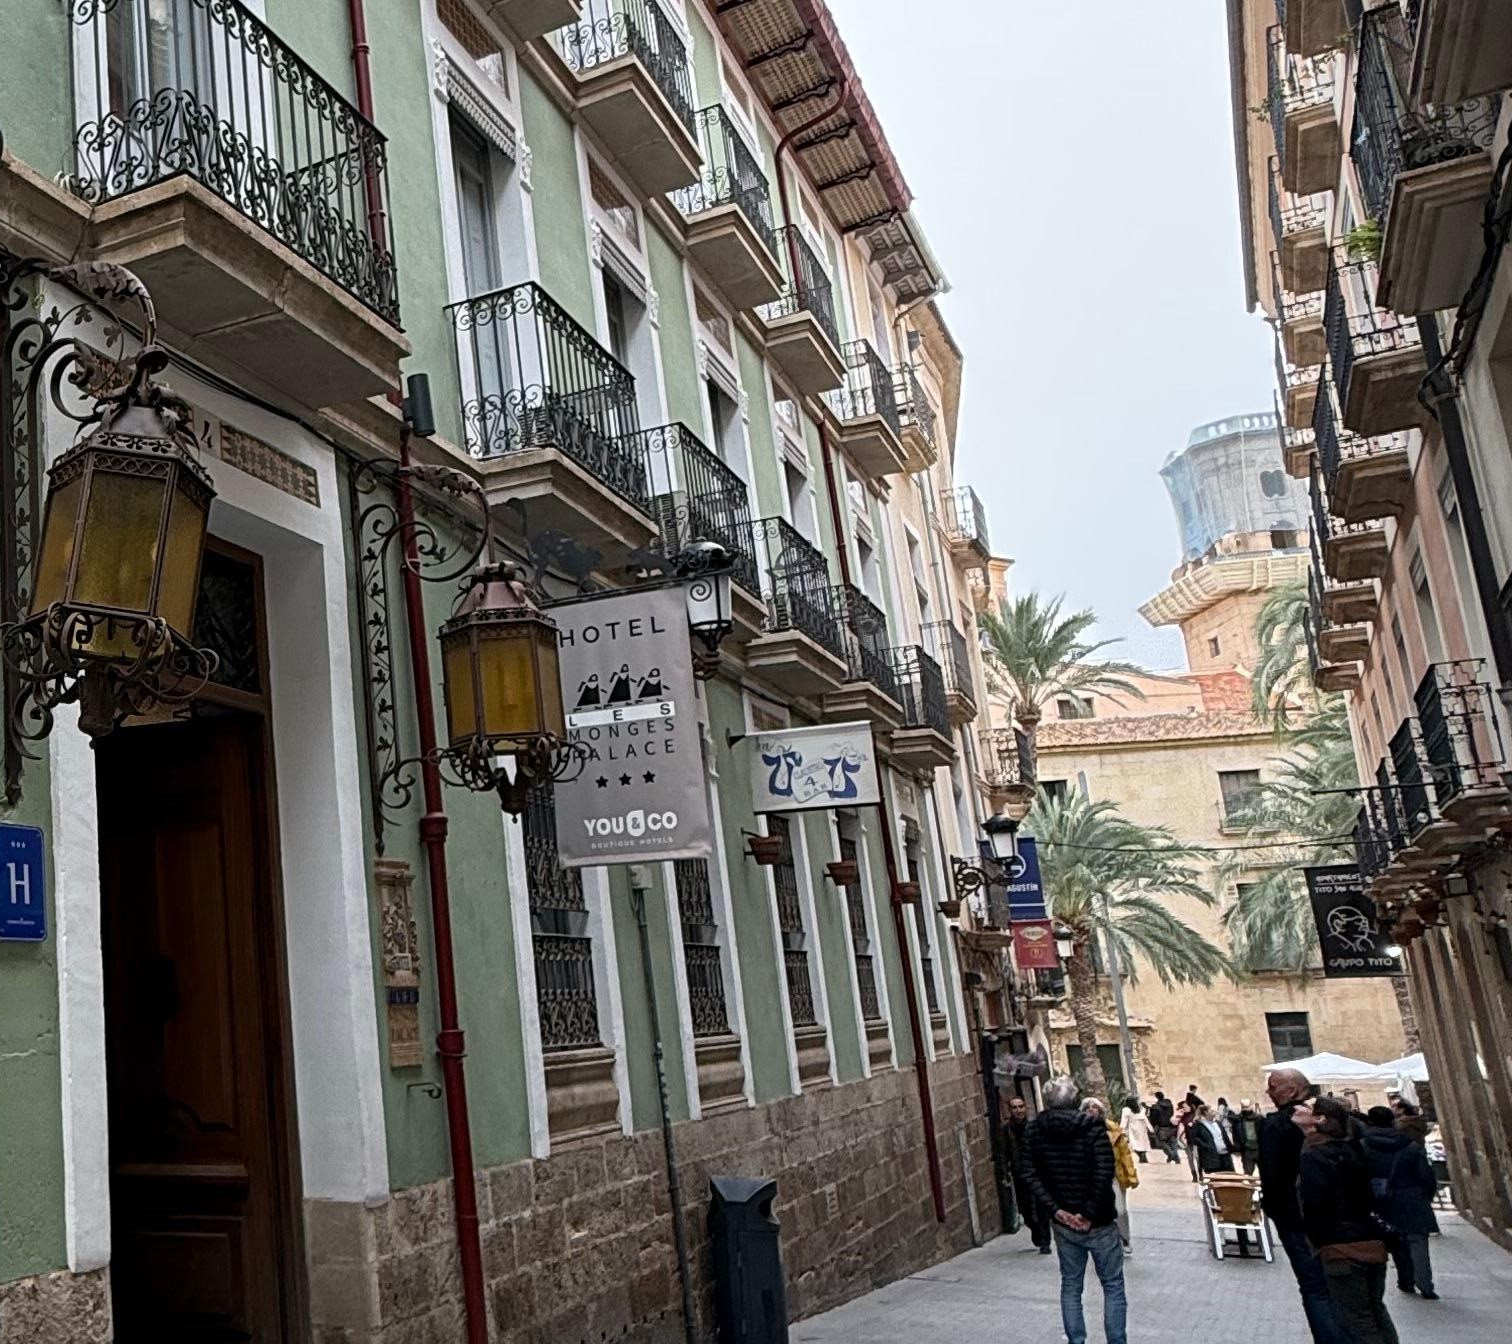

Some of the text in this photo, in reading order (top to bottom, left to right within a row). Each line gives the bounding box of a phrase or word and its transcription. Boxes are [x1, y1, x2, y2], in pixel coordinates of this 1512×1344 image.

[560, 616, 665, 648] HOTEL
[569, 703, 671, 727] LES
[569, 717, 675, 742] MONGES
